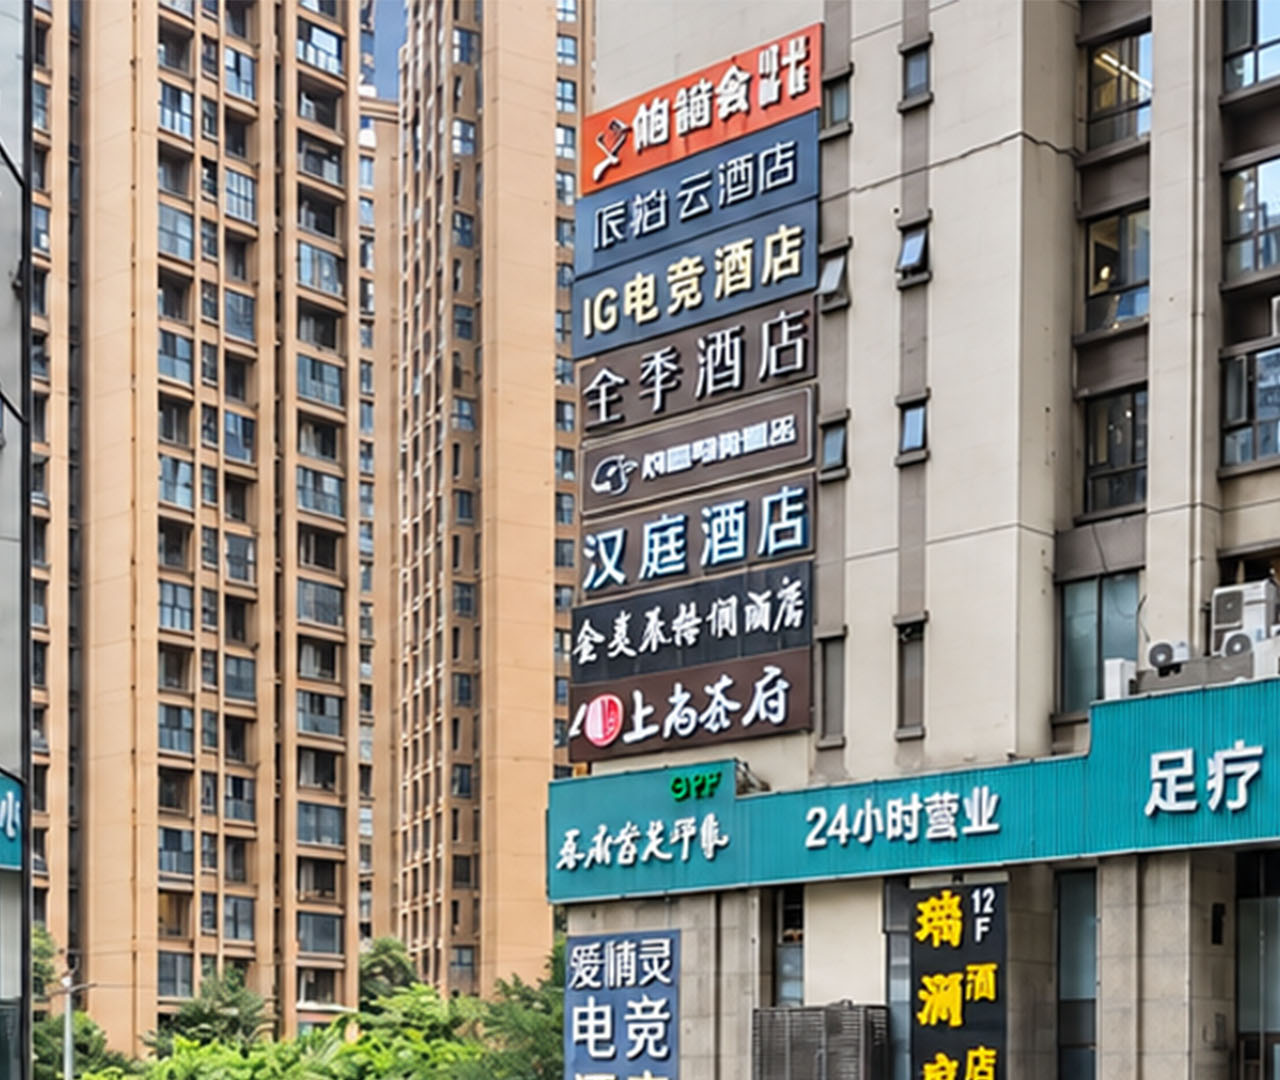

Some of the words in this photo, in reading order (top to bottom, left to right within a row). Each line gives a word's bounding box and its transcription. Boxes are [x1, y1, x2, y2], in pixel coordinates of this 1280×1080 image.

[583, 224, 804, 338] IG电竞酒店
[582, 309, 809, 428] 全季酒店
[582, 485, 807, 590] 汉庭酒店
[1144, 738, 1266, 817] 足疗
[805, 785, 1003, 849] 24小时营业
[971, 887, 996, 915] 12
[974, 917, 992, 942] F
[572, 994, 672, 1060] 电竞
